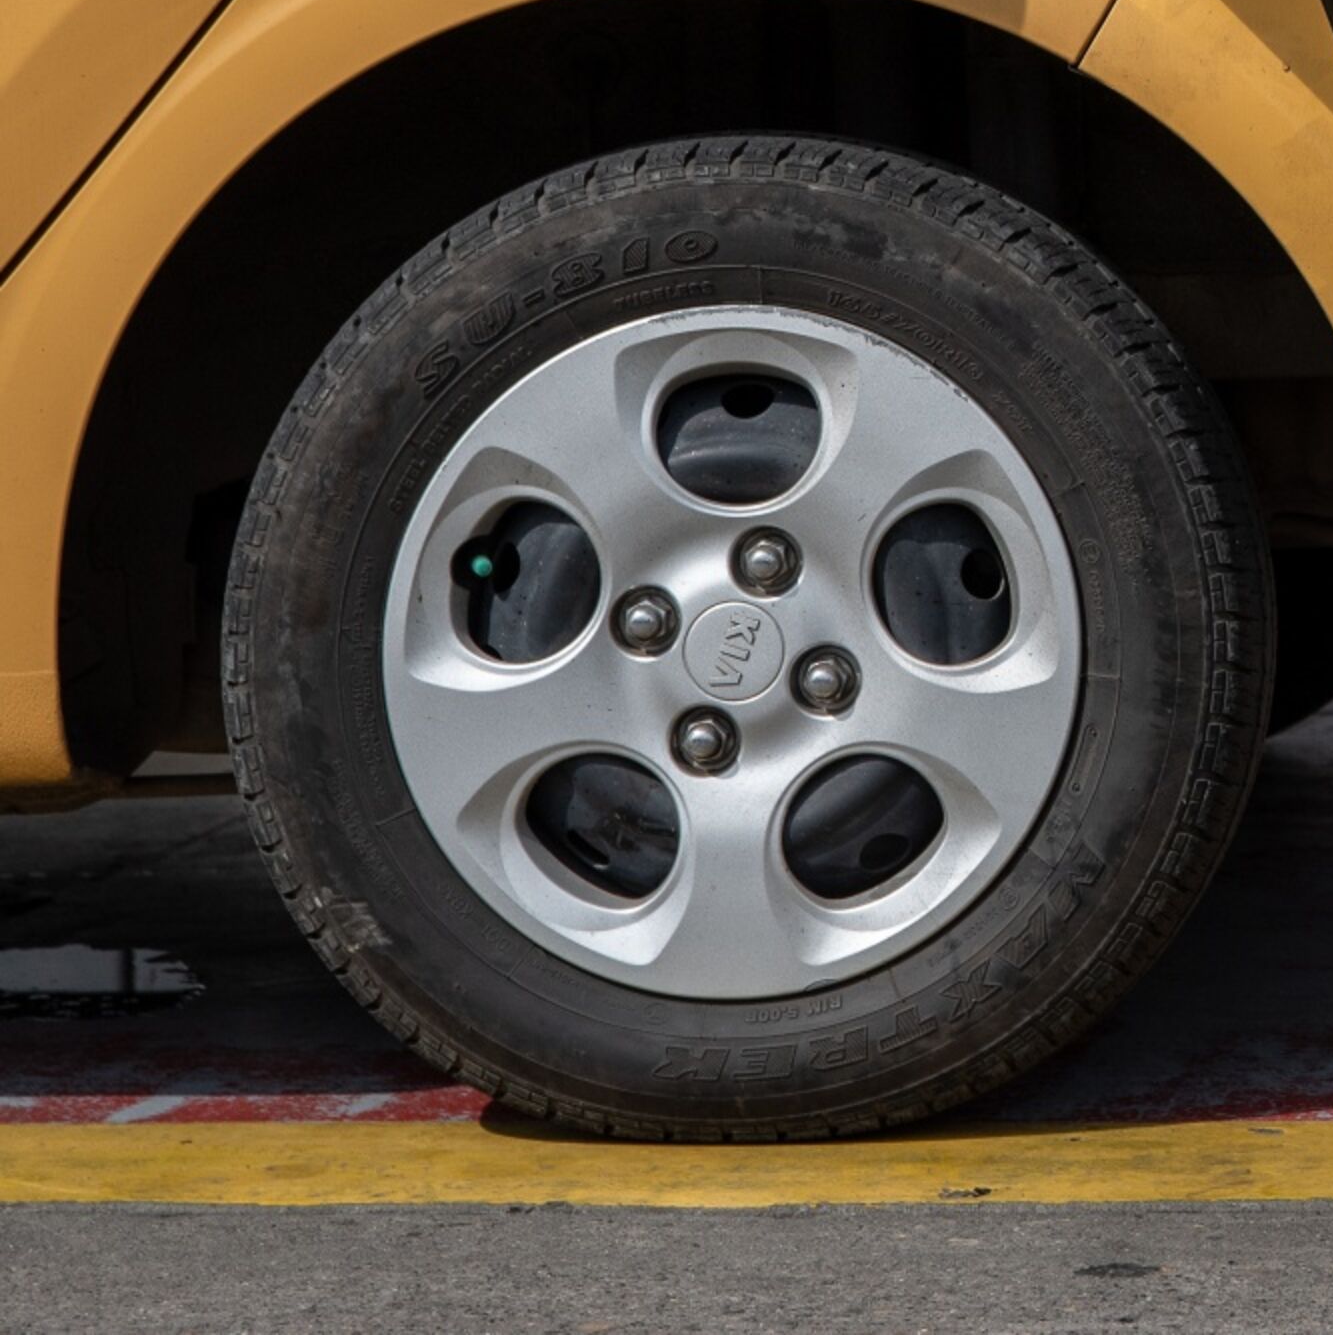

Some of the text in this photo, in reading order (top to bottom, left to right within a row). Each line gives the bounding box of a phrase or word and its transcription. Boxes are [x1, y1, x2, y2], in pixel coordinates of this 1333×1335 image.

[612, 279, 717, 310] TUBELESS
[708, 610, 761, 688] KIA
[805, 992, 843, 1016] RIM
